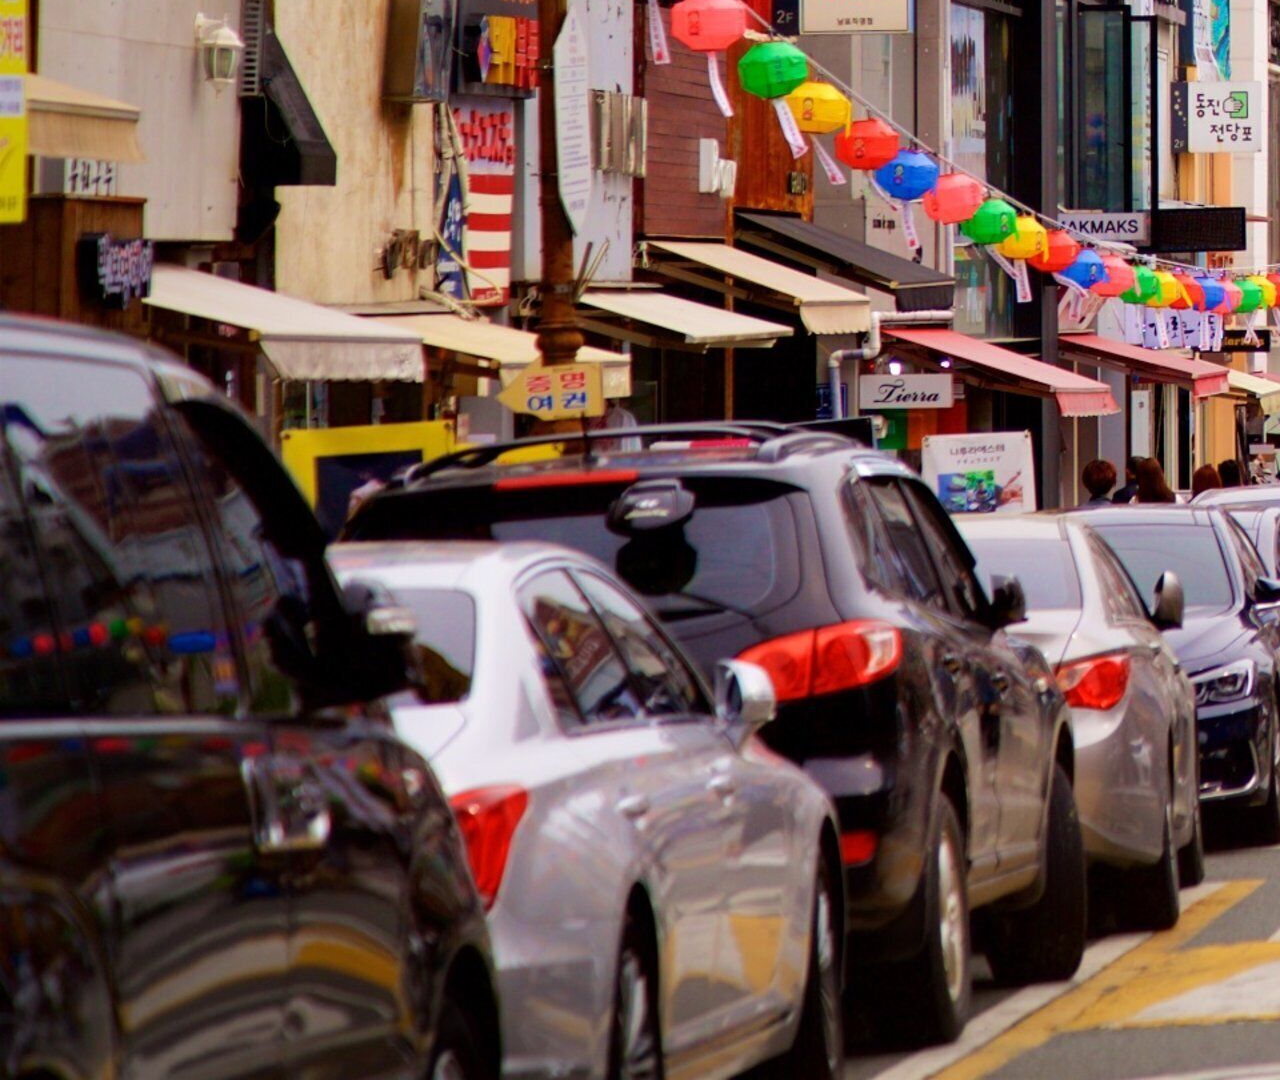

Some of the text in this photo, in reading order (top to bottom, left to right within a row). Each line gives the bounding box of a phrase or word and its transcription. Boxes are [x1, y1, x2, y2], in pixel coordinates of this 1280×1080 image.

[775, 10, 794, 24] 2F
[1195, 94, 1219, 118] 동진
[1210, 123, 1253, 143] 전당포
[1059, 218, 1139, 235] AKMAKS
[873, 378, 941, 404] Tierra
